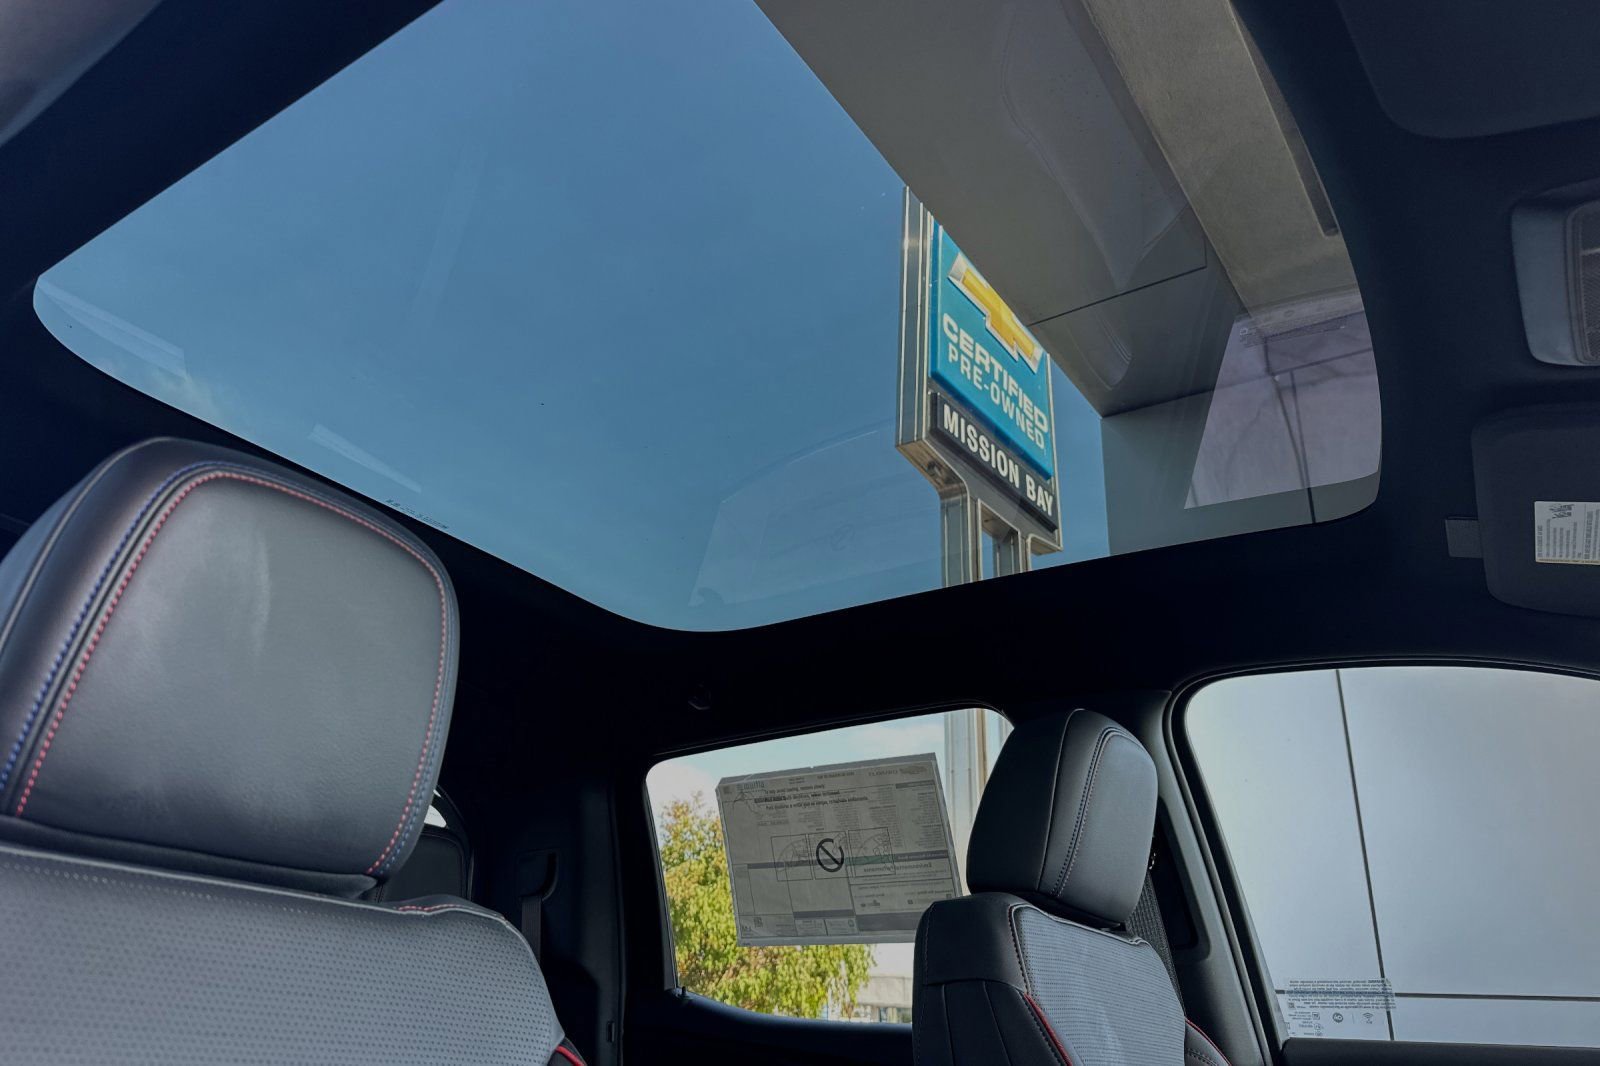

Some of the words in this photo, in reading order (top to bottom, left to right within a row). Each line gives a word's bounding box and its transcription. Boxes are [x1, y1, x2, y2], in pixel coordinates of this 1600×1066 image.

[942, 313, 1049, 433] CERTIFIED
[948, 343, 1045, 450] PRE-OWNED
[943, 403, 1020, 489] MISSION
[1025, 474, 1054, 517] BAY
